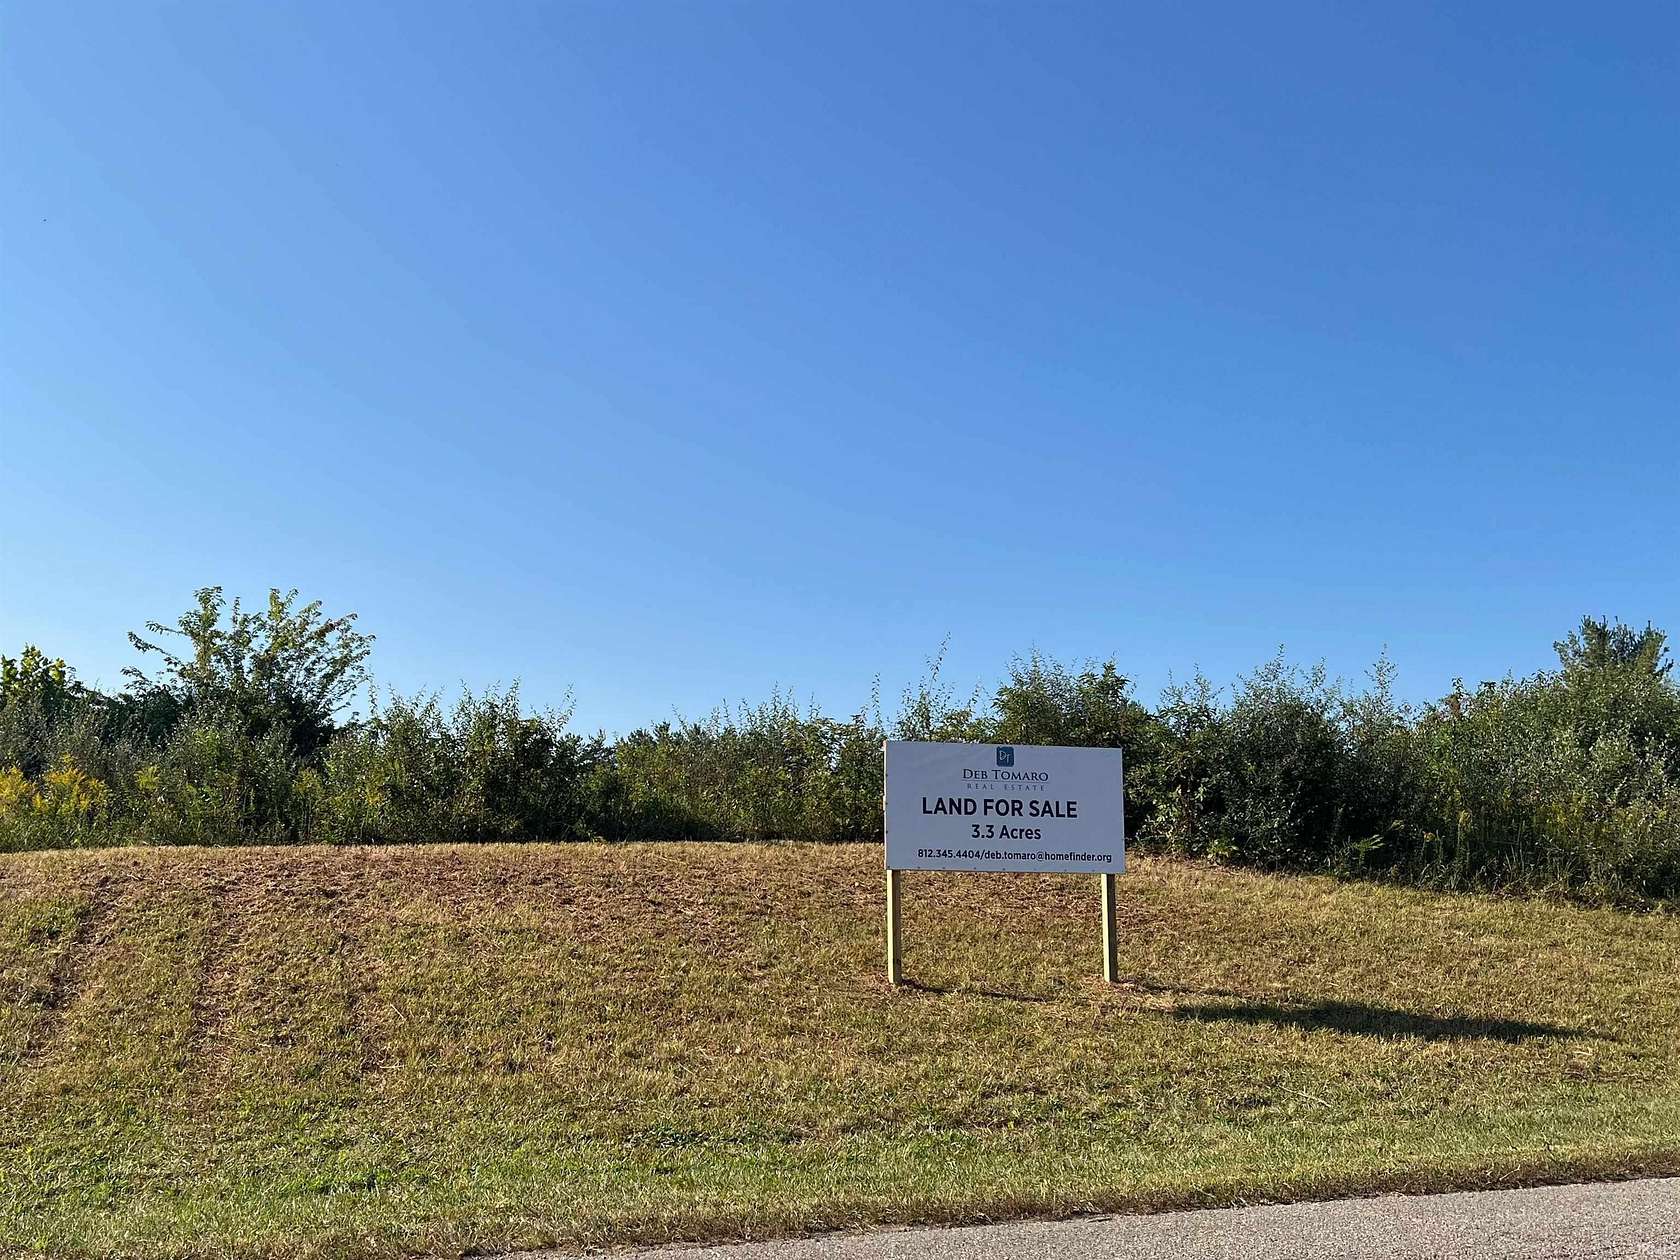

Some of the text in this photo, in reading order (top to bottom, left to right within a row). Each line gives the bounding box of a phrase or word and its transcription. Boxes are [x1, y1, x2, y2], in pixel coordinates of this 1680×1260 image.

[1004, 783, 1045, 791] ESTATE
[922, 797, 1078, 818] LAND FOR SALE
[971, 824, 1042, 840] 3.3 Acres
